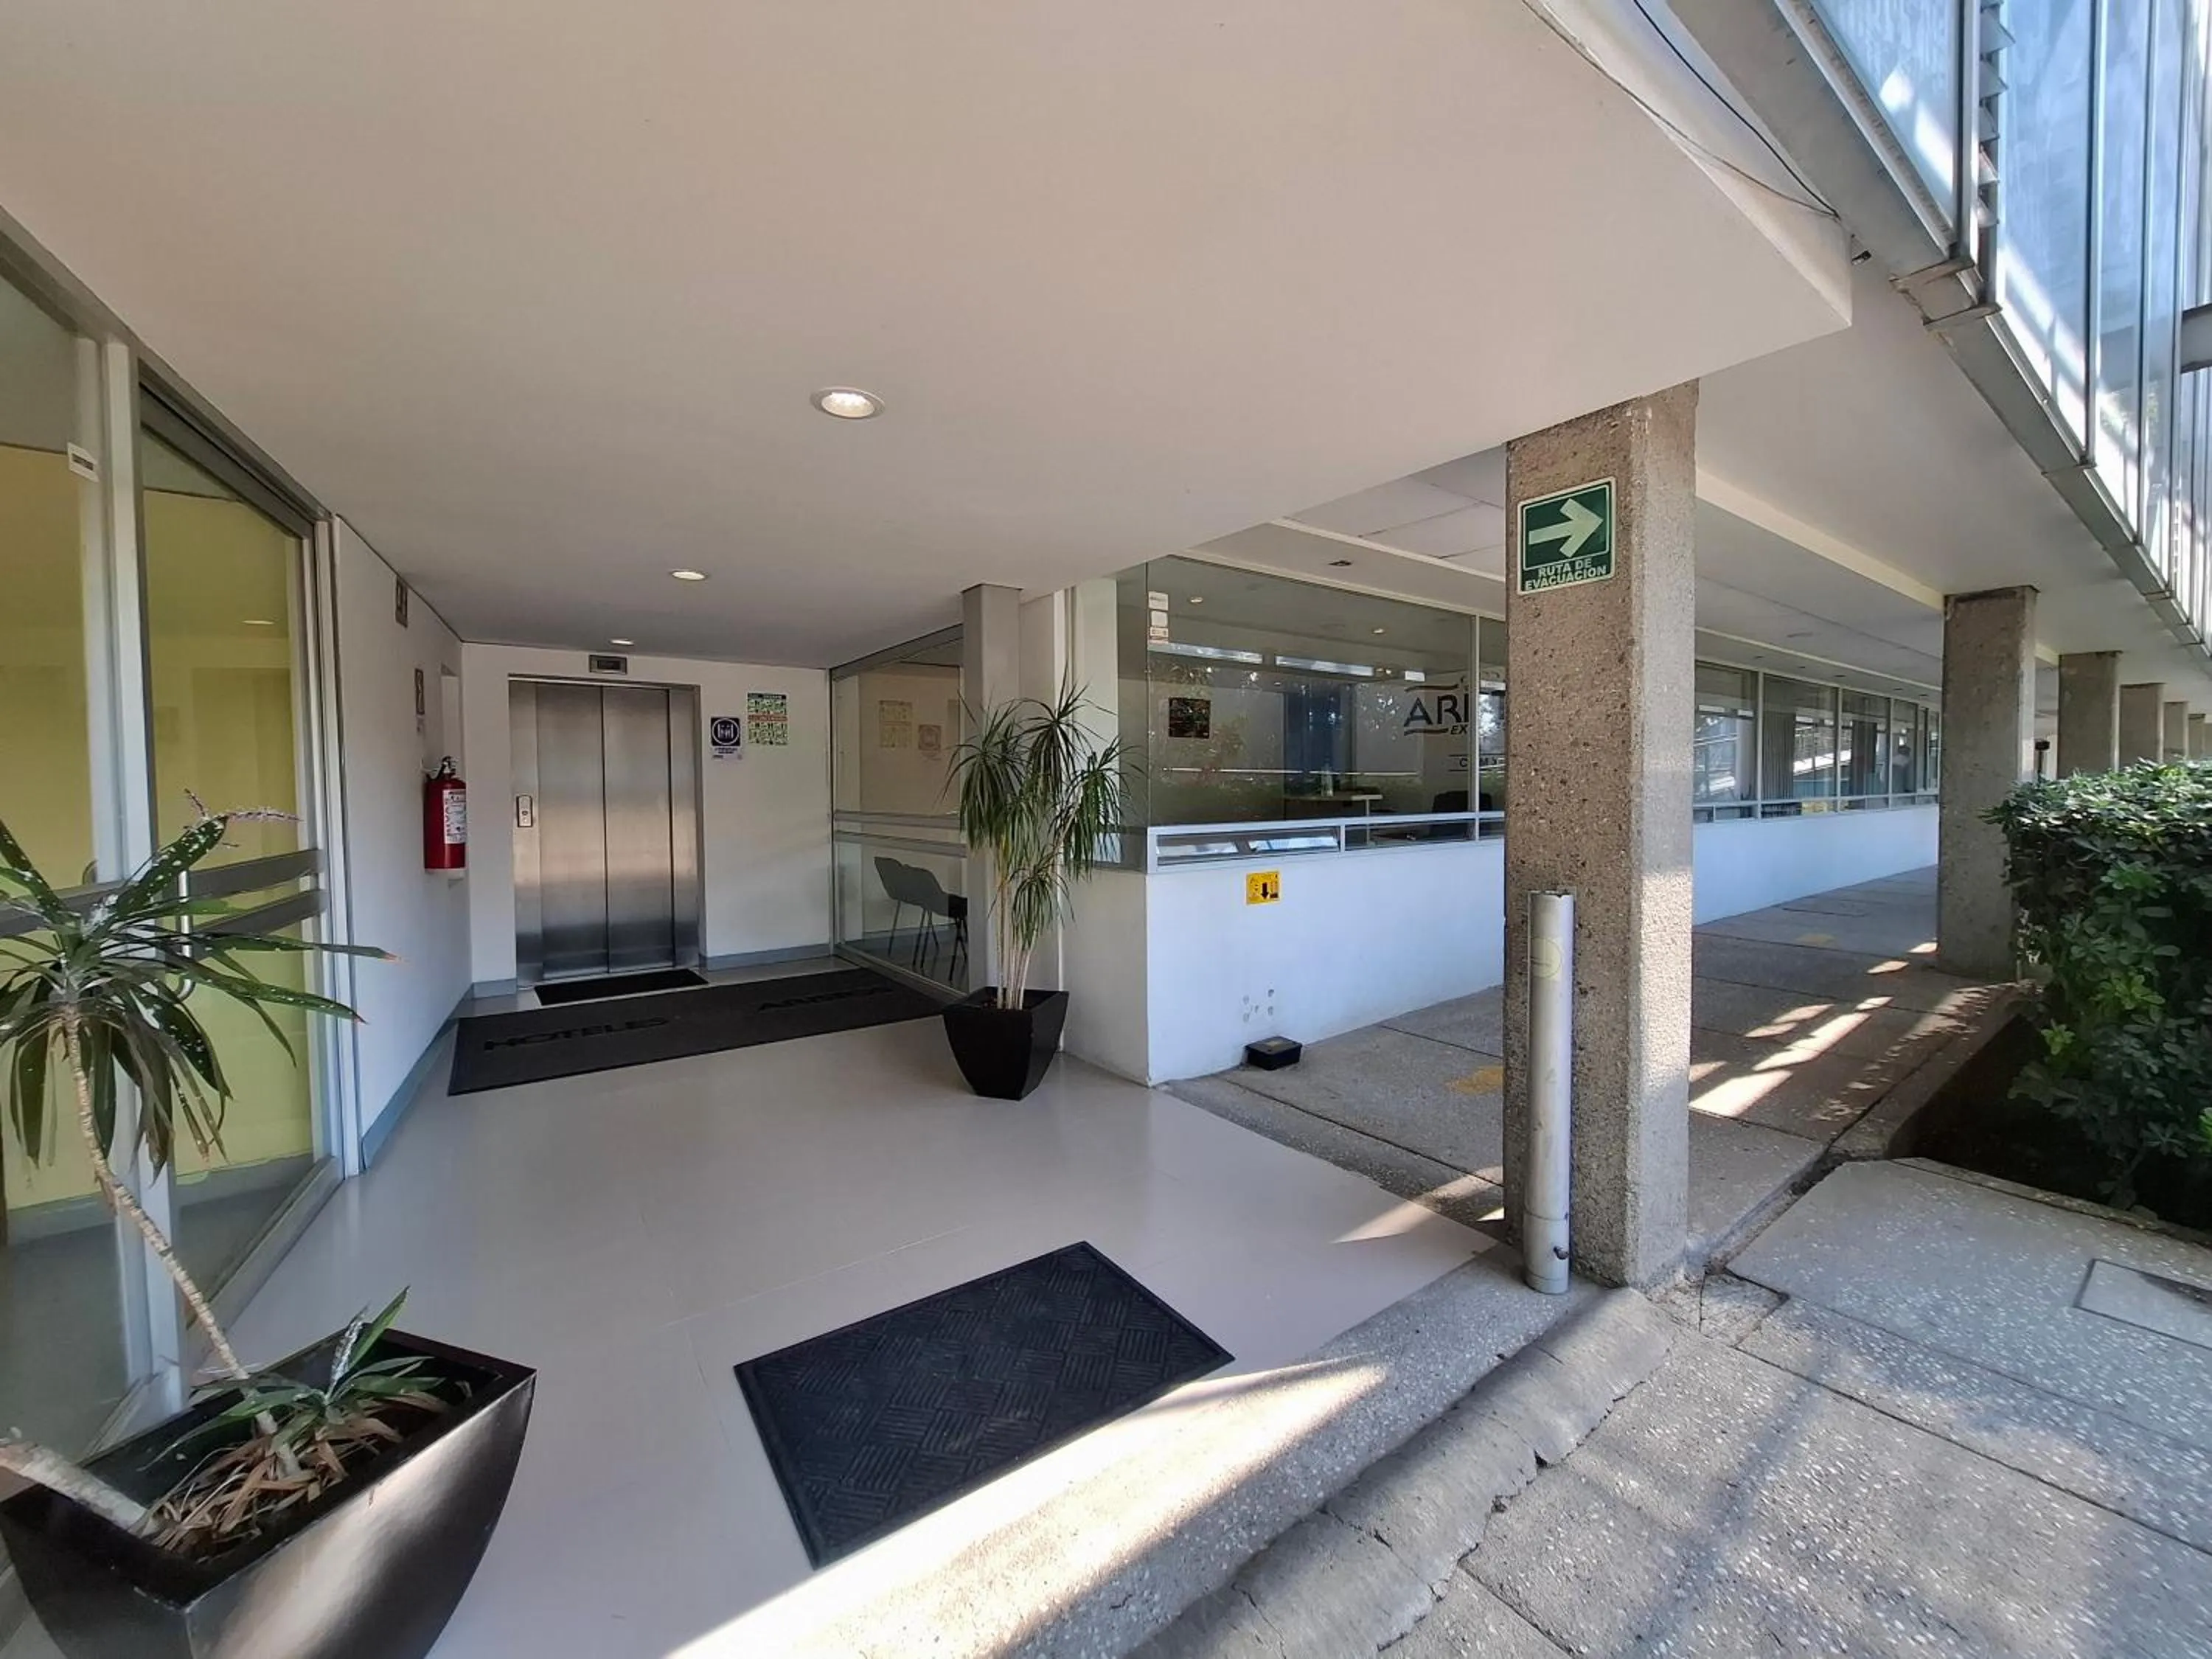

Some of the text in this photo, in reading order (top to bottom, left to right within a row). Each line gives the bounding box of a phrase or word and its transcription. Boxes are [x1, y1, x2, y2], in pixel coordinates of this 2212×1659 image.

[1525, 565, 1607, 591] EVACUACION
[1538, 558, 1593, 577] RUTA DE
[484, 1016, 669, 1051] HOTELES
